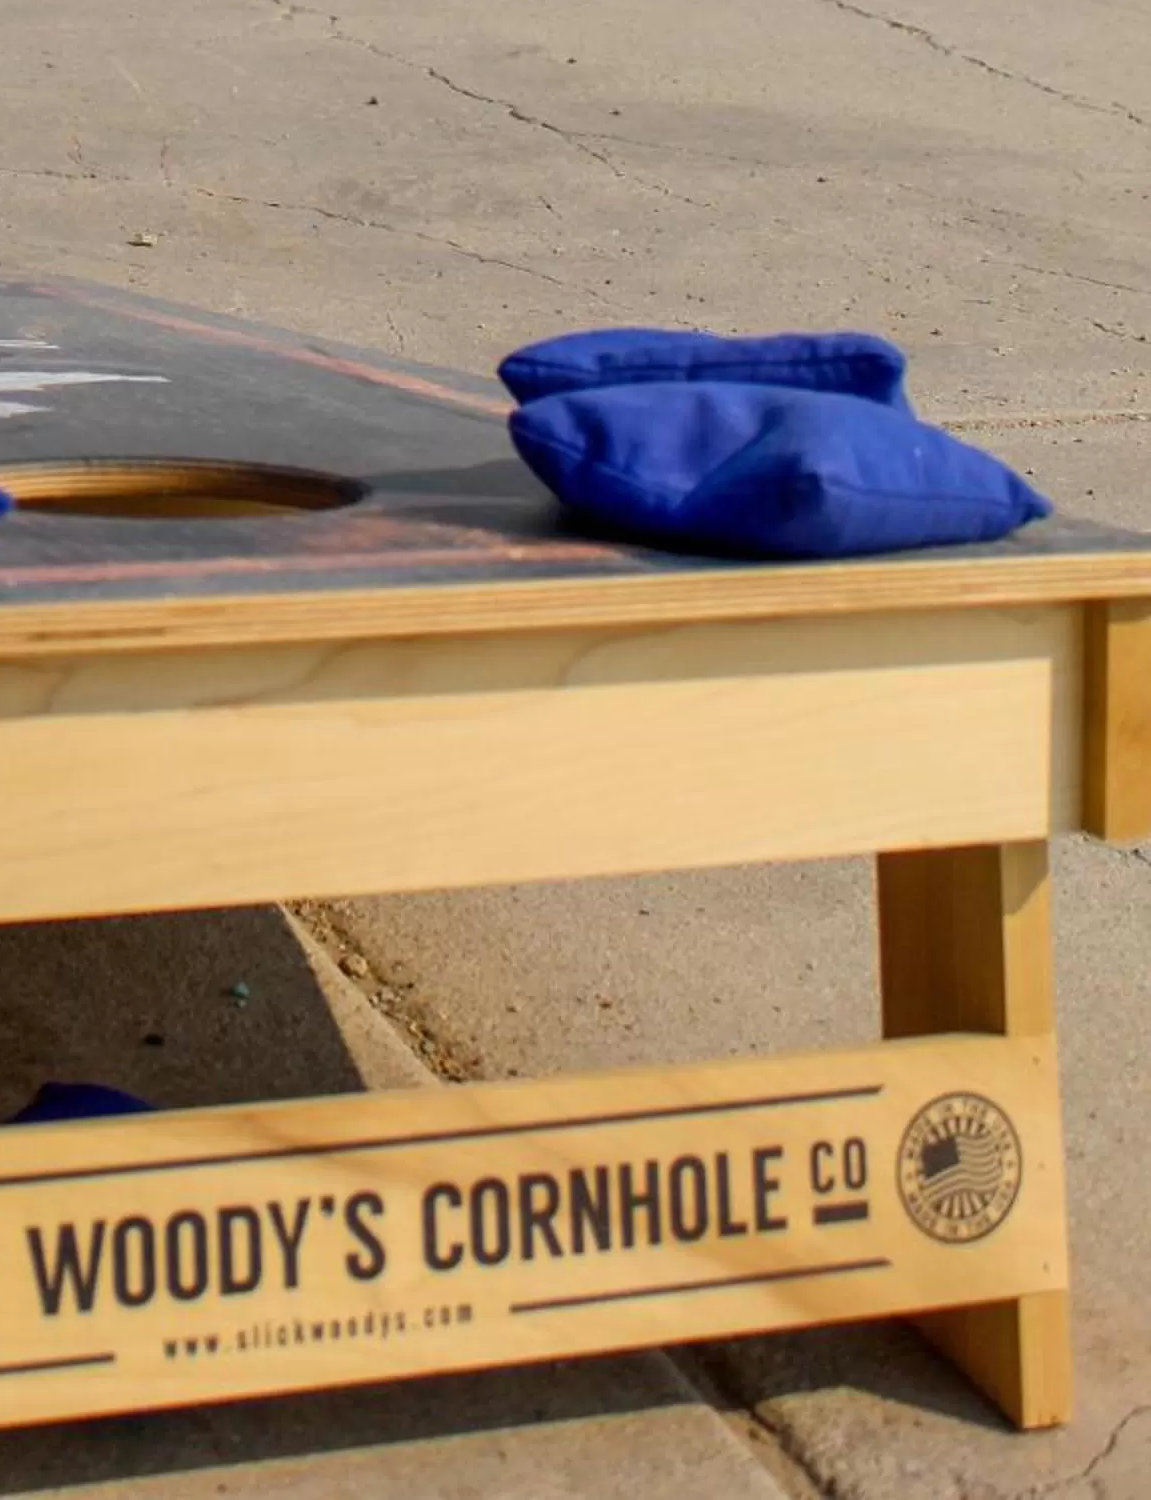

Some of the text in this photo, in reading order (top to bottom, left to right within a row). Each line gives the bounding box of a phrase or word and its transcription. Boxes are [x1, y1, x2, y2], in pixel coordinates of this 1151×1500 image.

[26, 1190, 387, 1316] WOODY'S
[422, 1145, 789, 1272] CORNHOLE
[810, 1136, 868, 1194] CO
[164, 1303, 473, 1358] www.slickwoodys.com
